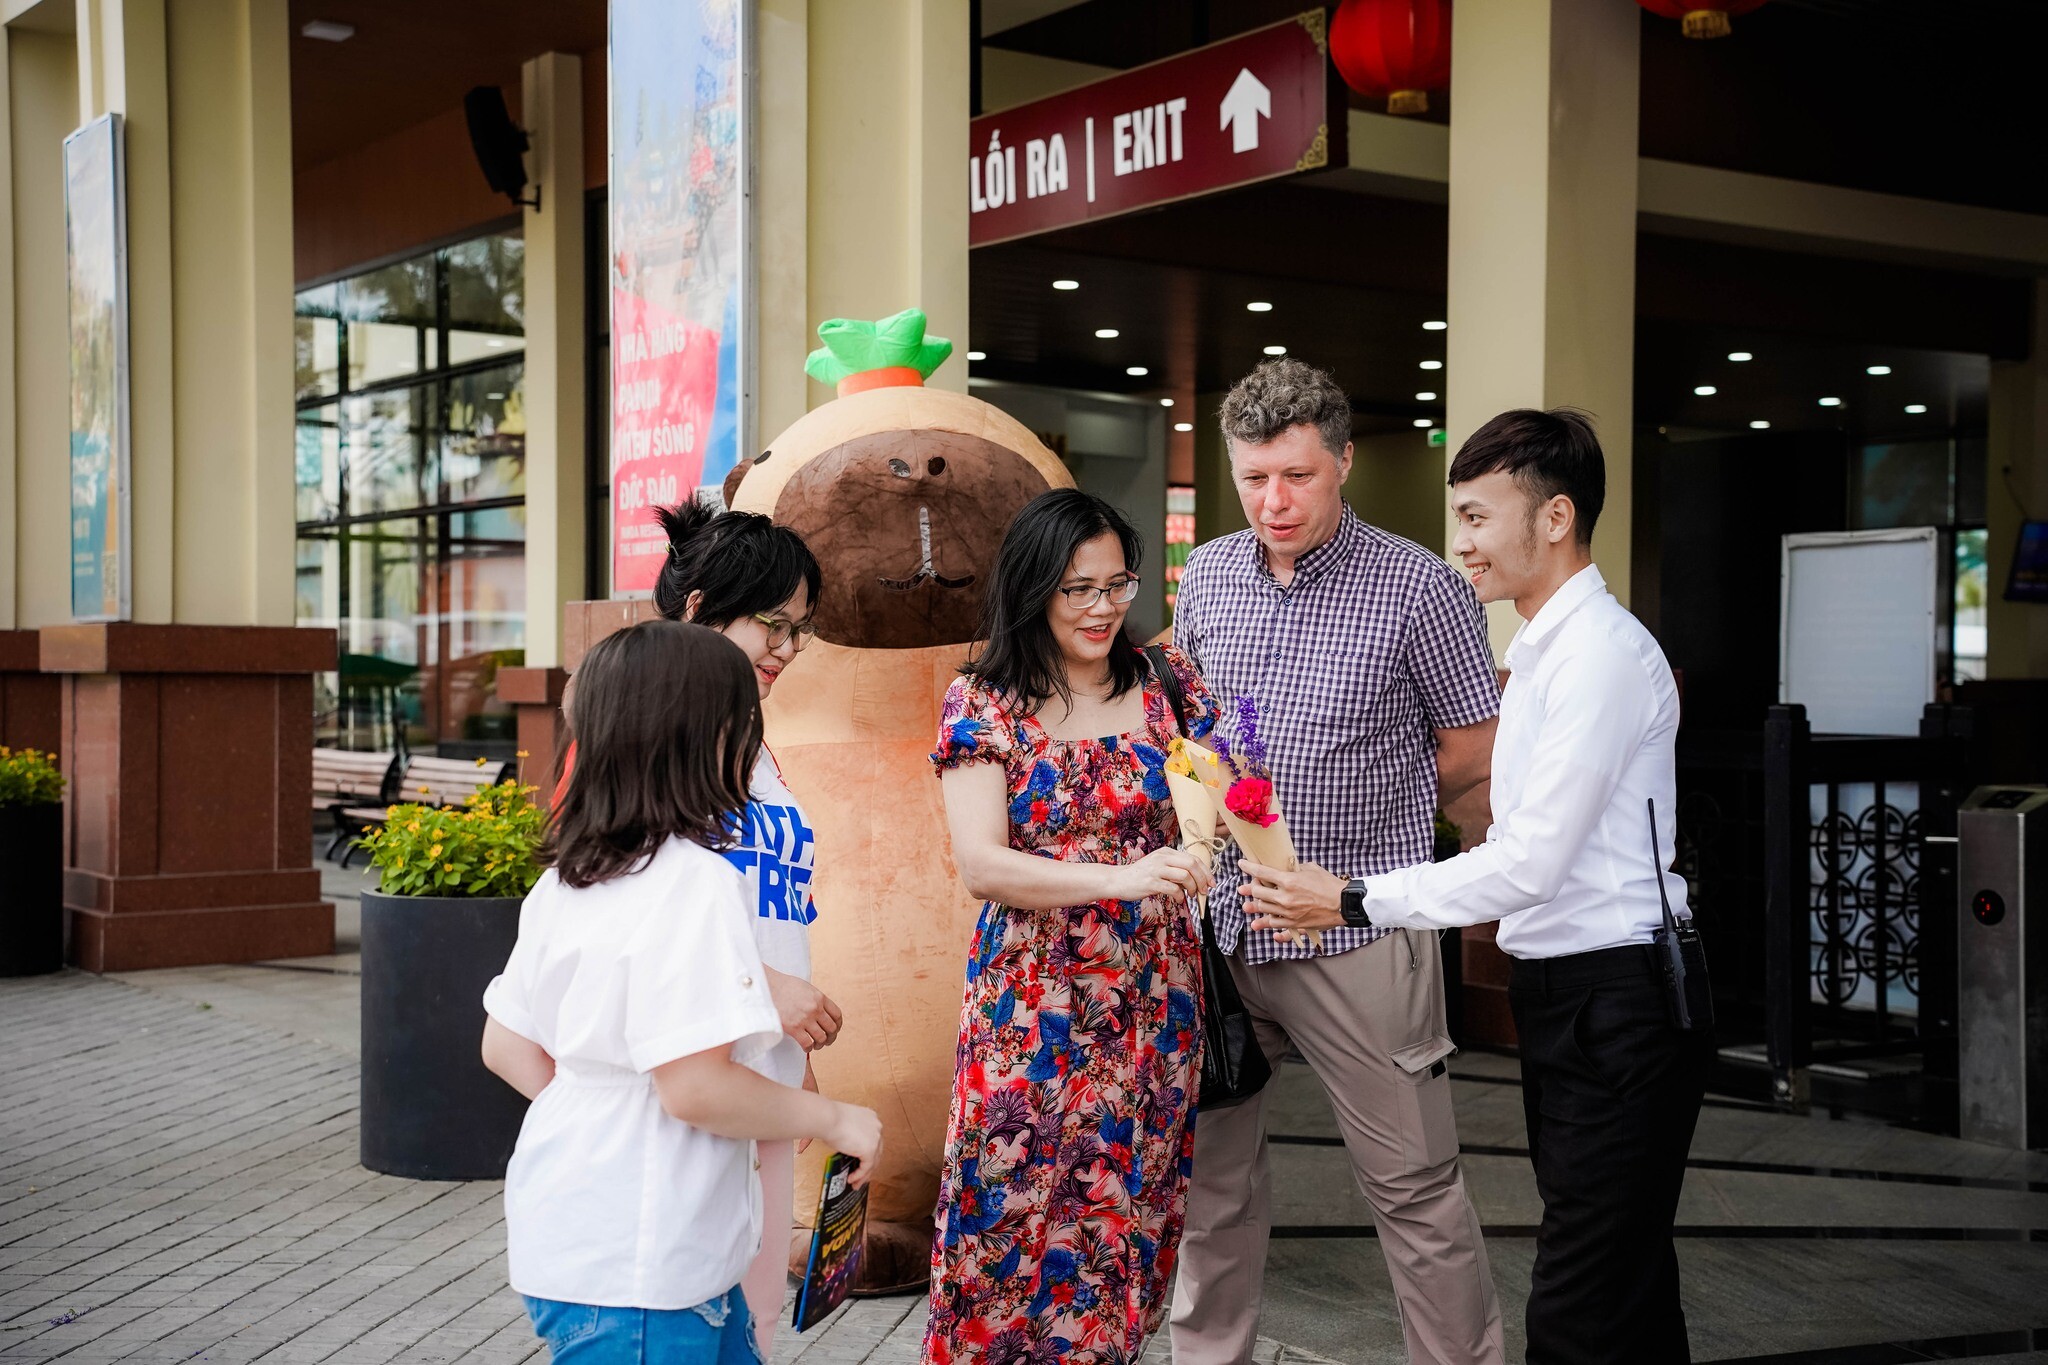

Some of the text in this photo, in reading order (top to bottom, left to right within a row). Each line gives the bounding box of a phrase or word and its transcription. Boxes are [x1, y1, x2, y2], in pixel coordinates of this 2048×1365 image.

[970, 129, 1016, 213] LỐI
[1026, 133, 1069, 200] RA
[1113, 97, 1187, 176] EXIT
[653, 418, 695, 457] SÔNG
